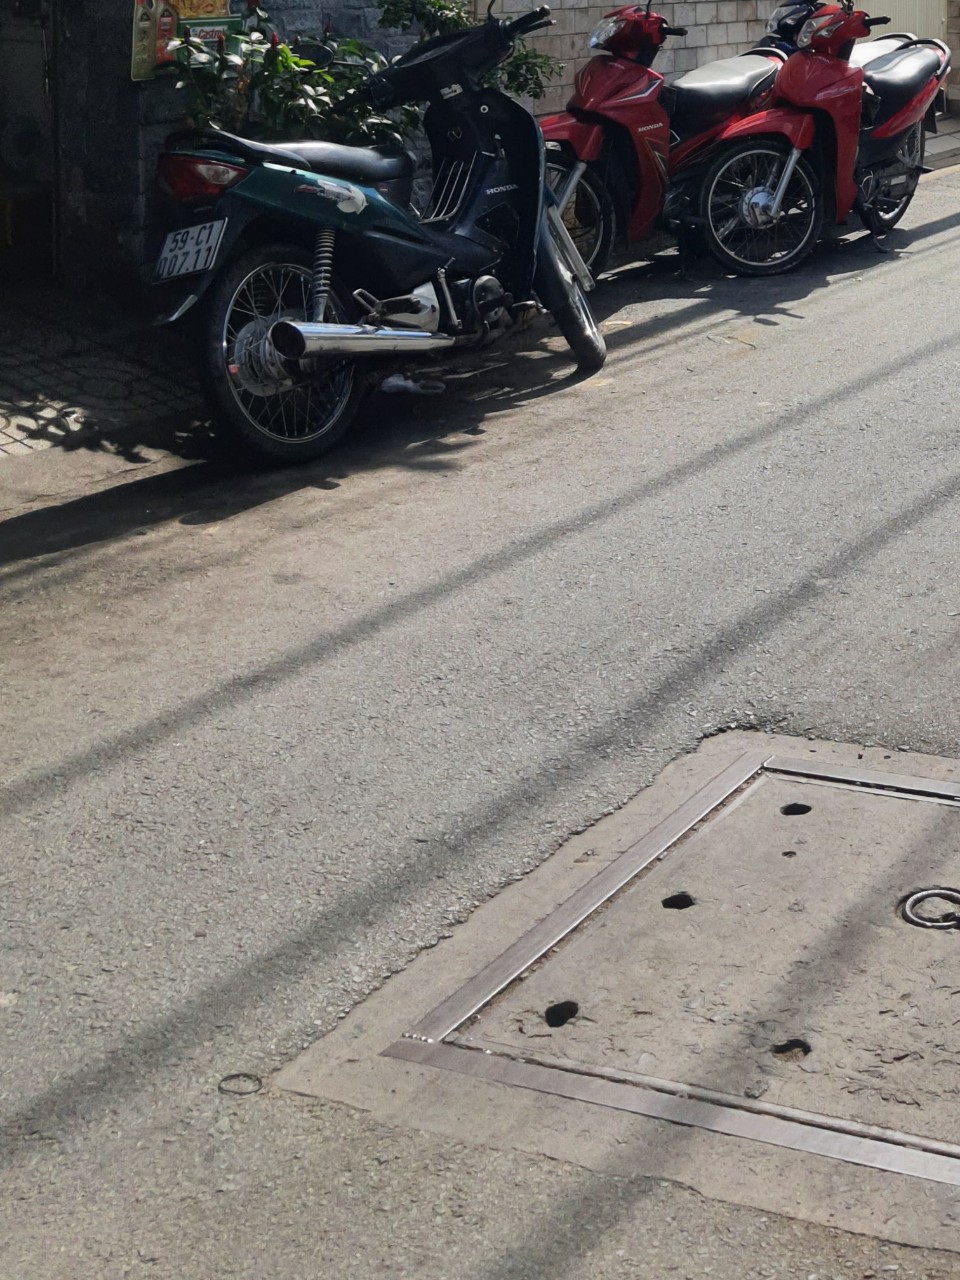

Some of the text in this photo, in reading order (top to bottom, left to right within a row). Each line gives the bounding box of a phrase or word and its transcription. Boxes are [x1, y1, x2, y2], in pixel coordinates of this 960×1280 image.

[638, 122, 664, 133] HONDA
[486, 183, 519, 195] HONDA
[169, 223, 214, 253] 59-C1
